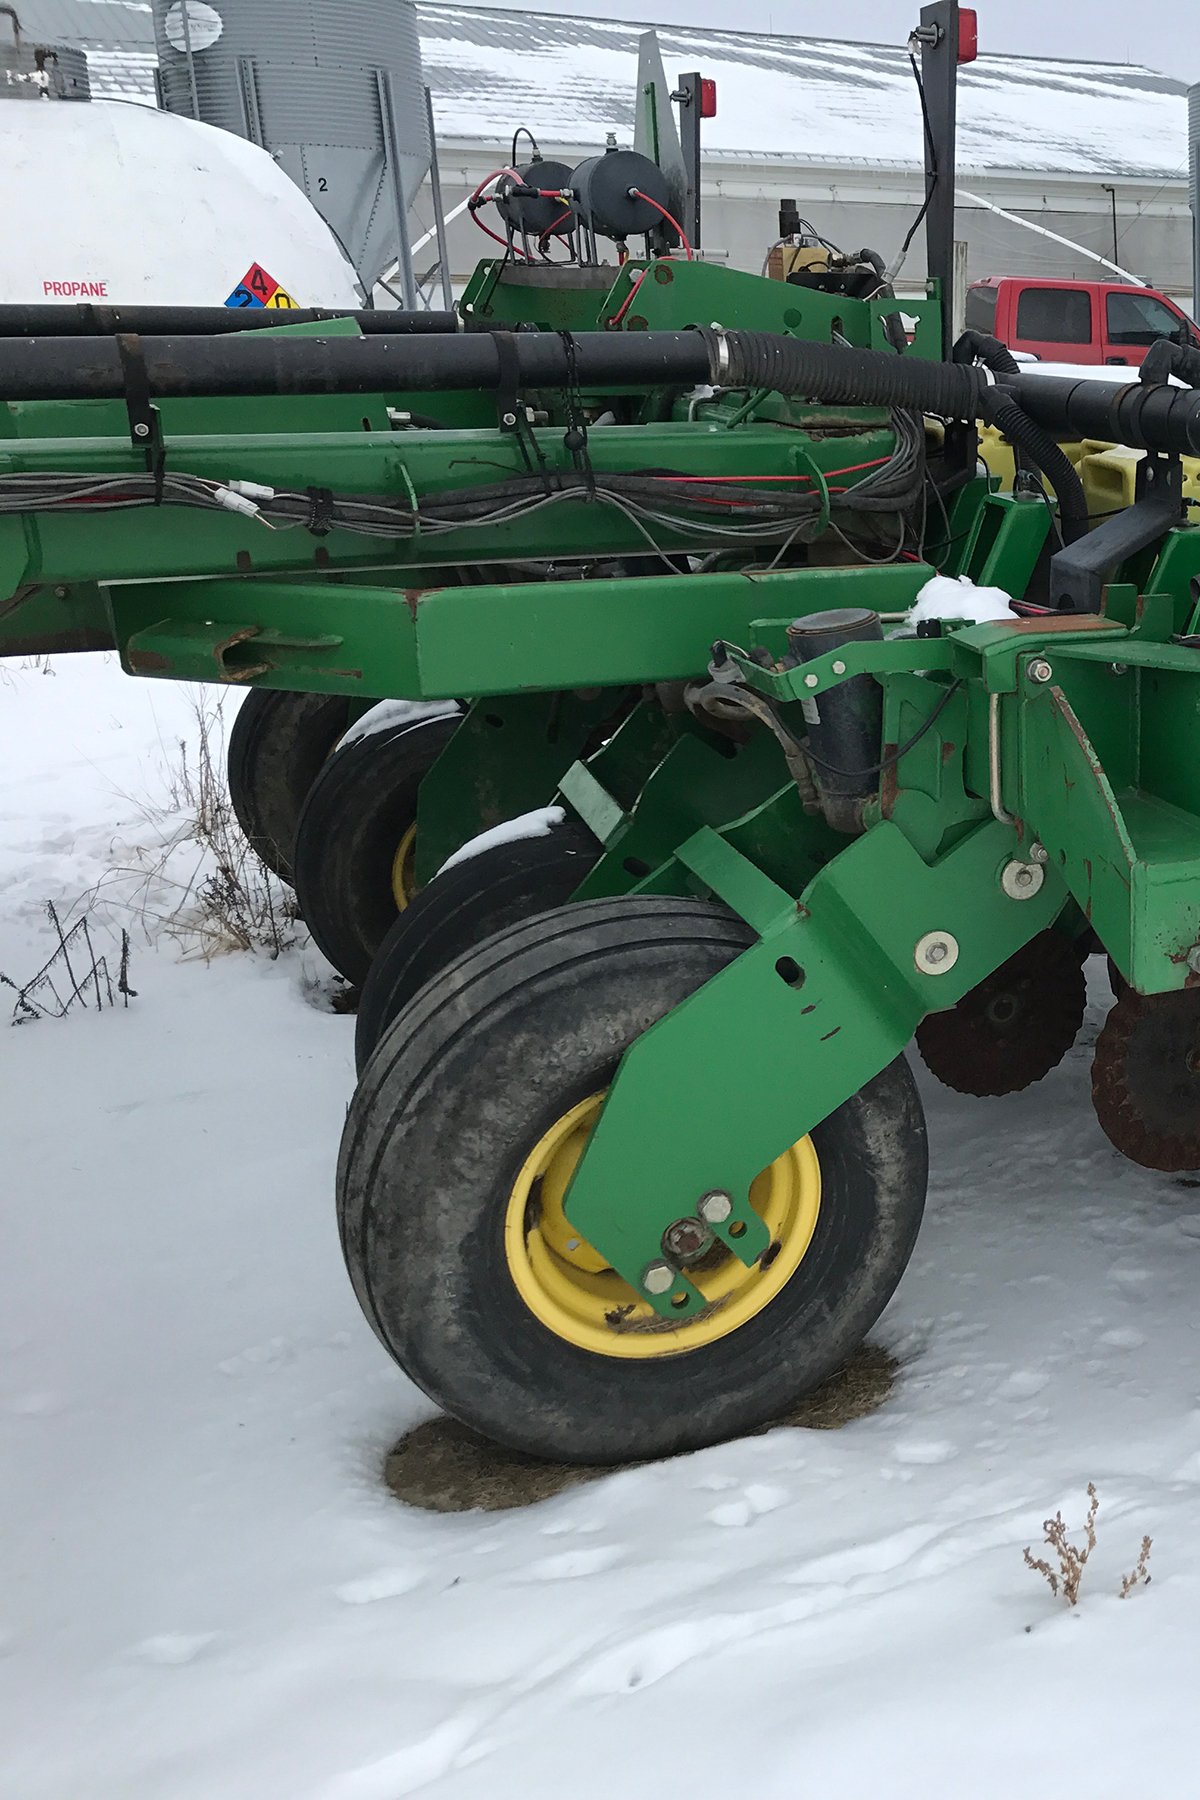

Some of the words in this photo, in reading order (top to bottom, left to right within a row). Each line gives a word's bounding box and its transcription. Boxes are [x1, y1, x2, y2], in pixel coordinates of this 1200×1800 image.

[318, 177, 328, 192] 2
[43, 281, 108, 297] PROPANE
[251, 269, 268, 295] 4
